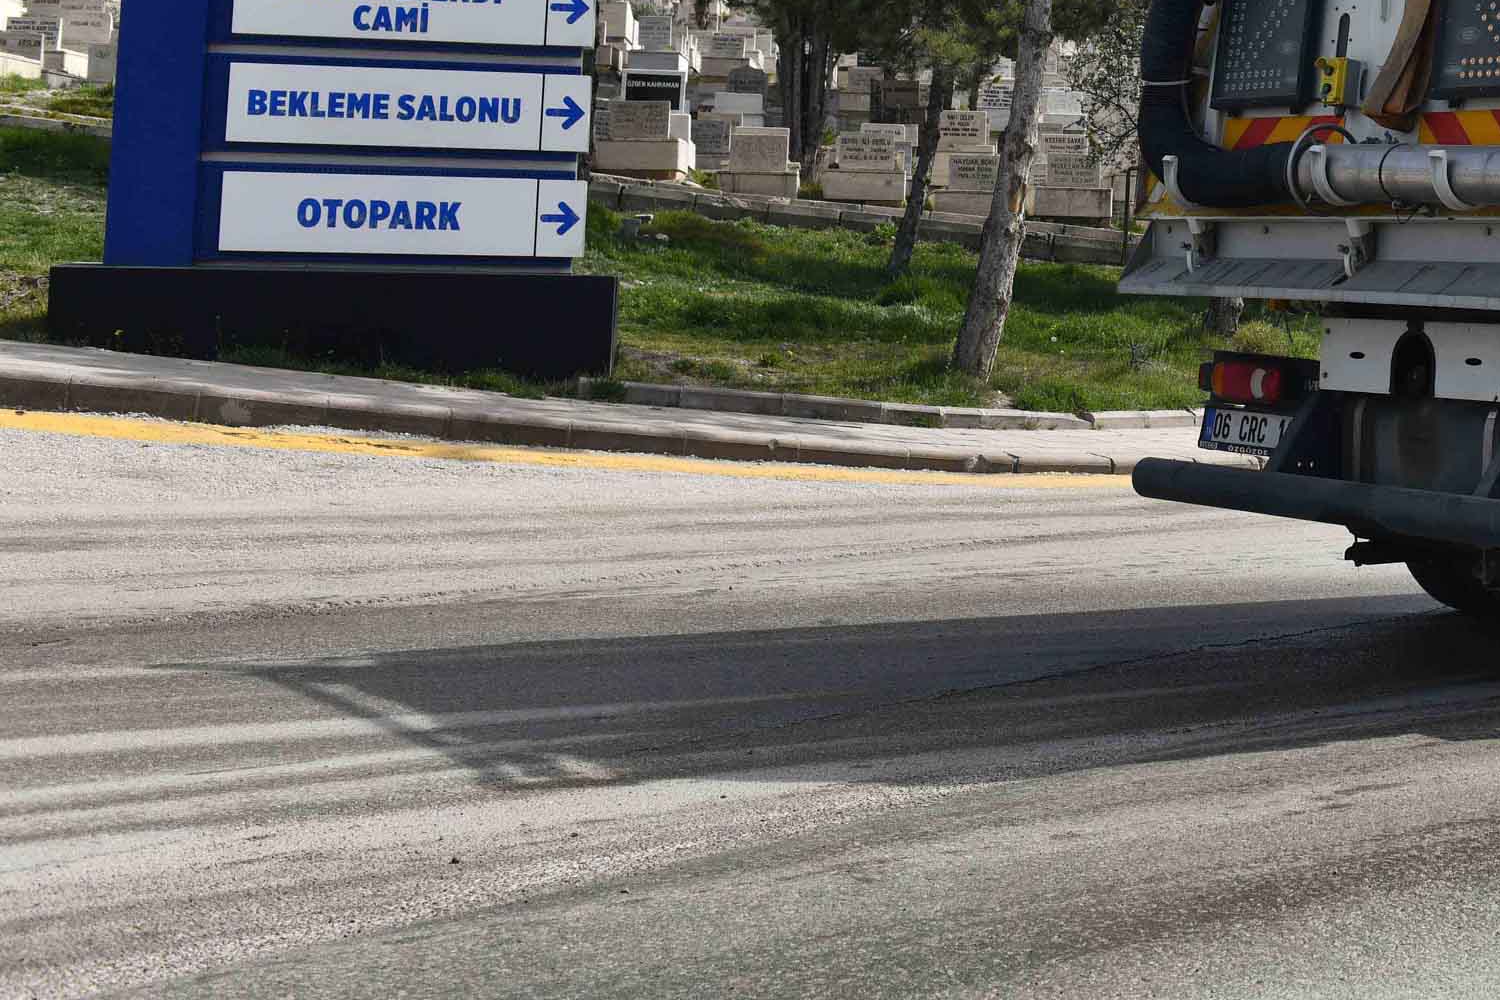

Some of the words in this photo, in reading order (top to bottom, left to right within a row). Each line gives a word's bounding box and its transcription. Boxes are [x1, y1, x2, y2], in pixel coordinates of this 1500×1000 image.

[352, 2, 429, 33] CAMİ
[247, 88, 390, 120] BEKLEME
[396, 95, 521, 125] SALONU
[296, 198, 462, 232] OTOPARK
[1213, 413, 1232, 439] 06
[1239, 415, 1268, 443] CRC
